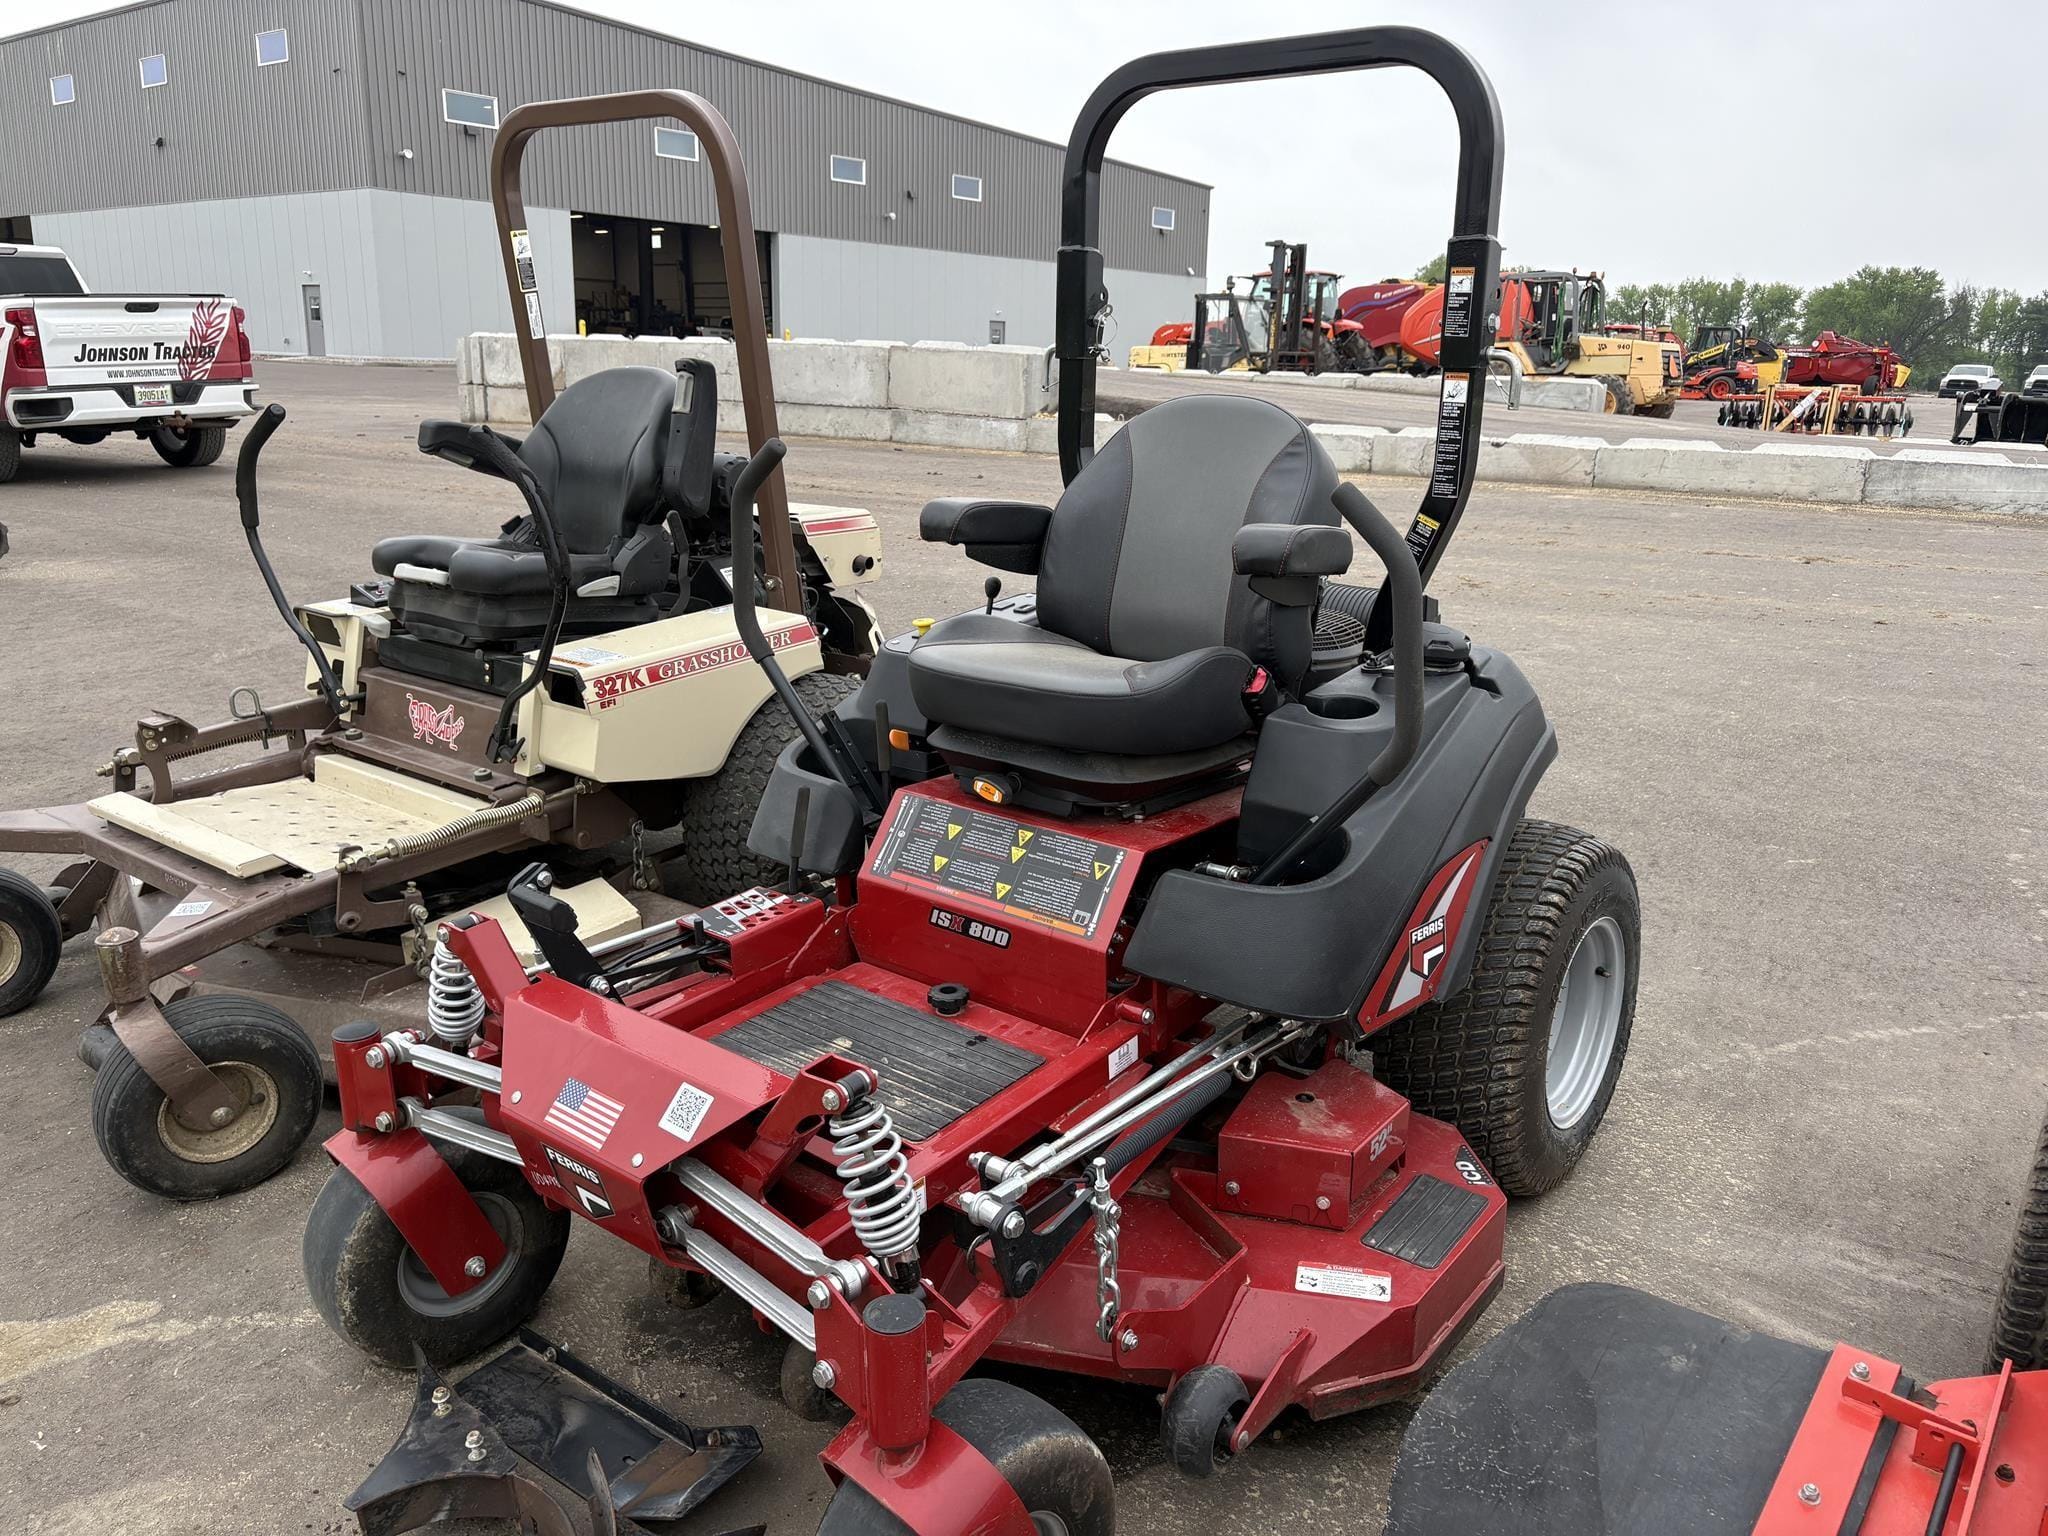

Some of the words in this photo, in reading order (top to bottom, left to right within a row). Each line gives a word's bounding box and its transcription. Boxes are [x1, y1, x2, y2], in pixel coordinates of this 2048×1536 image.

[55, 321, 188, 336] CHEVROL
[74, 343, 149, 362] JOHNSON
[153, 342, 216, 360] TRACTOR
[593, 668, 646, 699] 327K
[658, 631, 792, 680] GRASSHOER
[600, 699, 617, 710] EFI
[930, 909, 965, 933] ISX
[968, 921, 1010, 947] 800
[1411, 917, 1444, 945] FERRIS
[546, 1147, 600, 1184] FERRIS
[1332, 1263, 1364, 1274] DANGER
